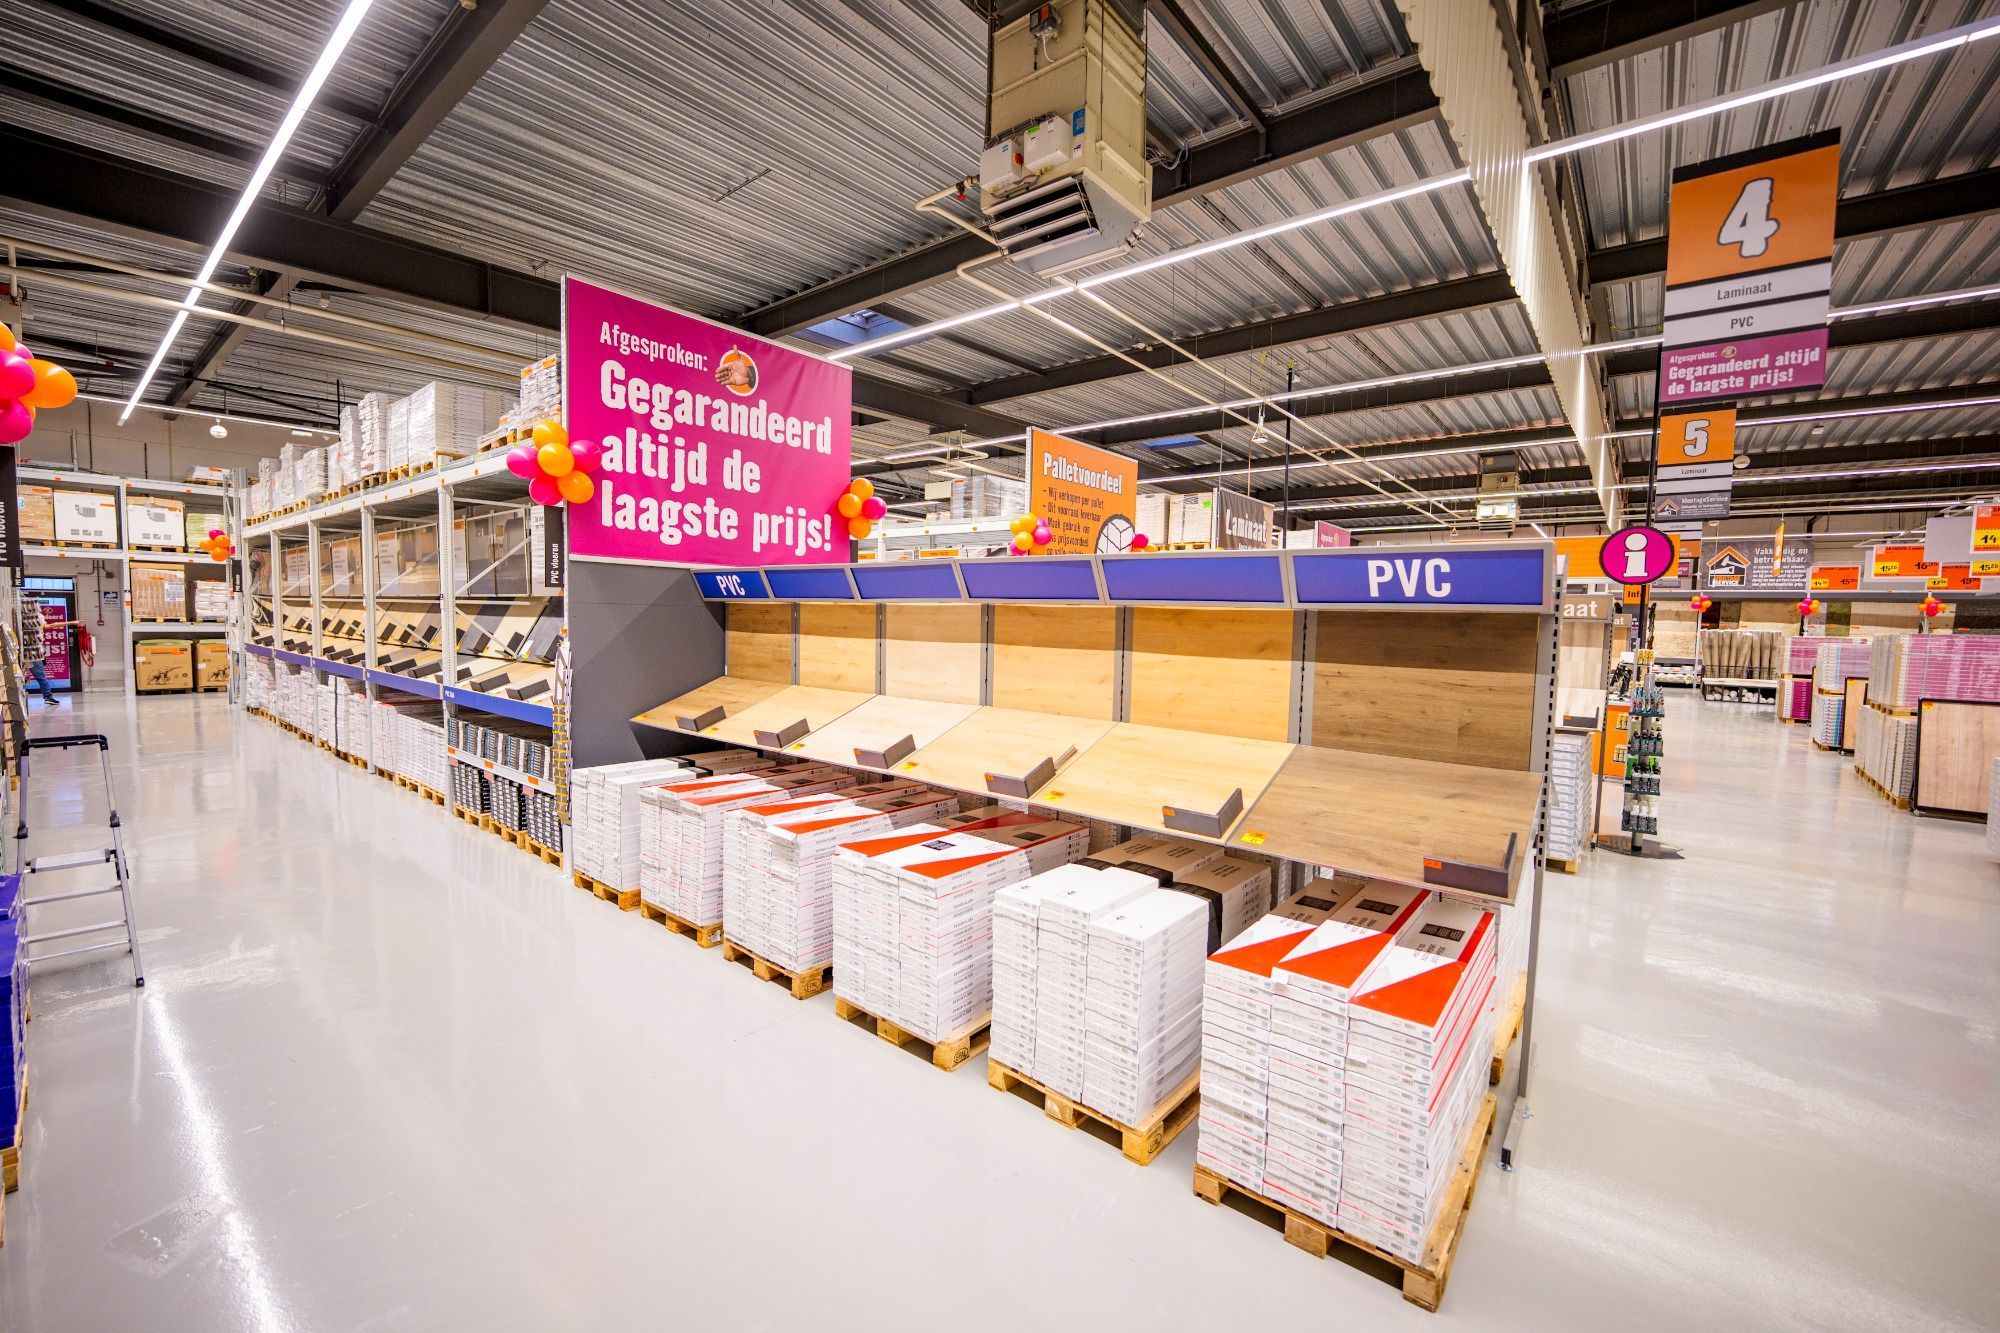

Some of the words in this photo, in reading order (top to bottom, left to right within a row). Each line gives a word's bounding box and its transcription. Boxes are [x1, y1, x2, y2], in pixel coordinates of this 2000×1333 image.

[1717, 177, 1780, 258] 4
[1717, 281, 1773, 301] Laminaat
[1730, 316, 1754, 329] PVC
[600, 321, 708, 372] Afgesproken:
[1670, 351, 1718, 364] Afgesproken:
[1668, 354, 1769, 380] Gegarandeerd
[1775, 347, 1820, 366] altijd
[1667, 382, 1684, 395] de
[1690, 375, 1745, 393] laagste
[1750, 368, 1794, 388] prijs!
[600, 359, 832, 456] Gegarandeerd
[1682, 419, 1711, 457] 5
[601, 427, 708, 493] altijd
[723, 449, 761, 494] de
[1043, 452, 1123, 494] Palletvoordeel
[1059, 490, 1081, 504] verkopen
[1081, 496, 1090, 507] per
[1091, 498, 1104, 509] pallet
[1681, 496, 1729, 504] MontageService
[601, 480, 739, 545] laagste
[753, 505, 832, 557] prijs!
[1226, 508, 1267, 543] Laminaat
[1058, 533, 1089, 547] prijsvoordeel
[1755, 546, 1795, 556] Vakkdig
[550, 543, 559, 569] vloeren
[1754, 556, 1807, 564] betrowbaar.
[551, 570, 559, 584] PVC
[716, 574, 746, 596] PVC
[1367, 557, 1452, 598] PVC
[1563, 600, 1598, 617] aat
